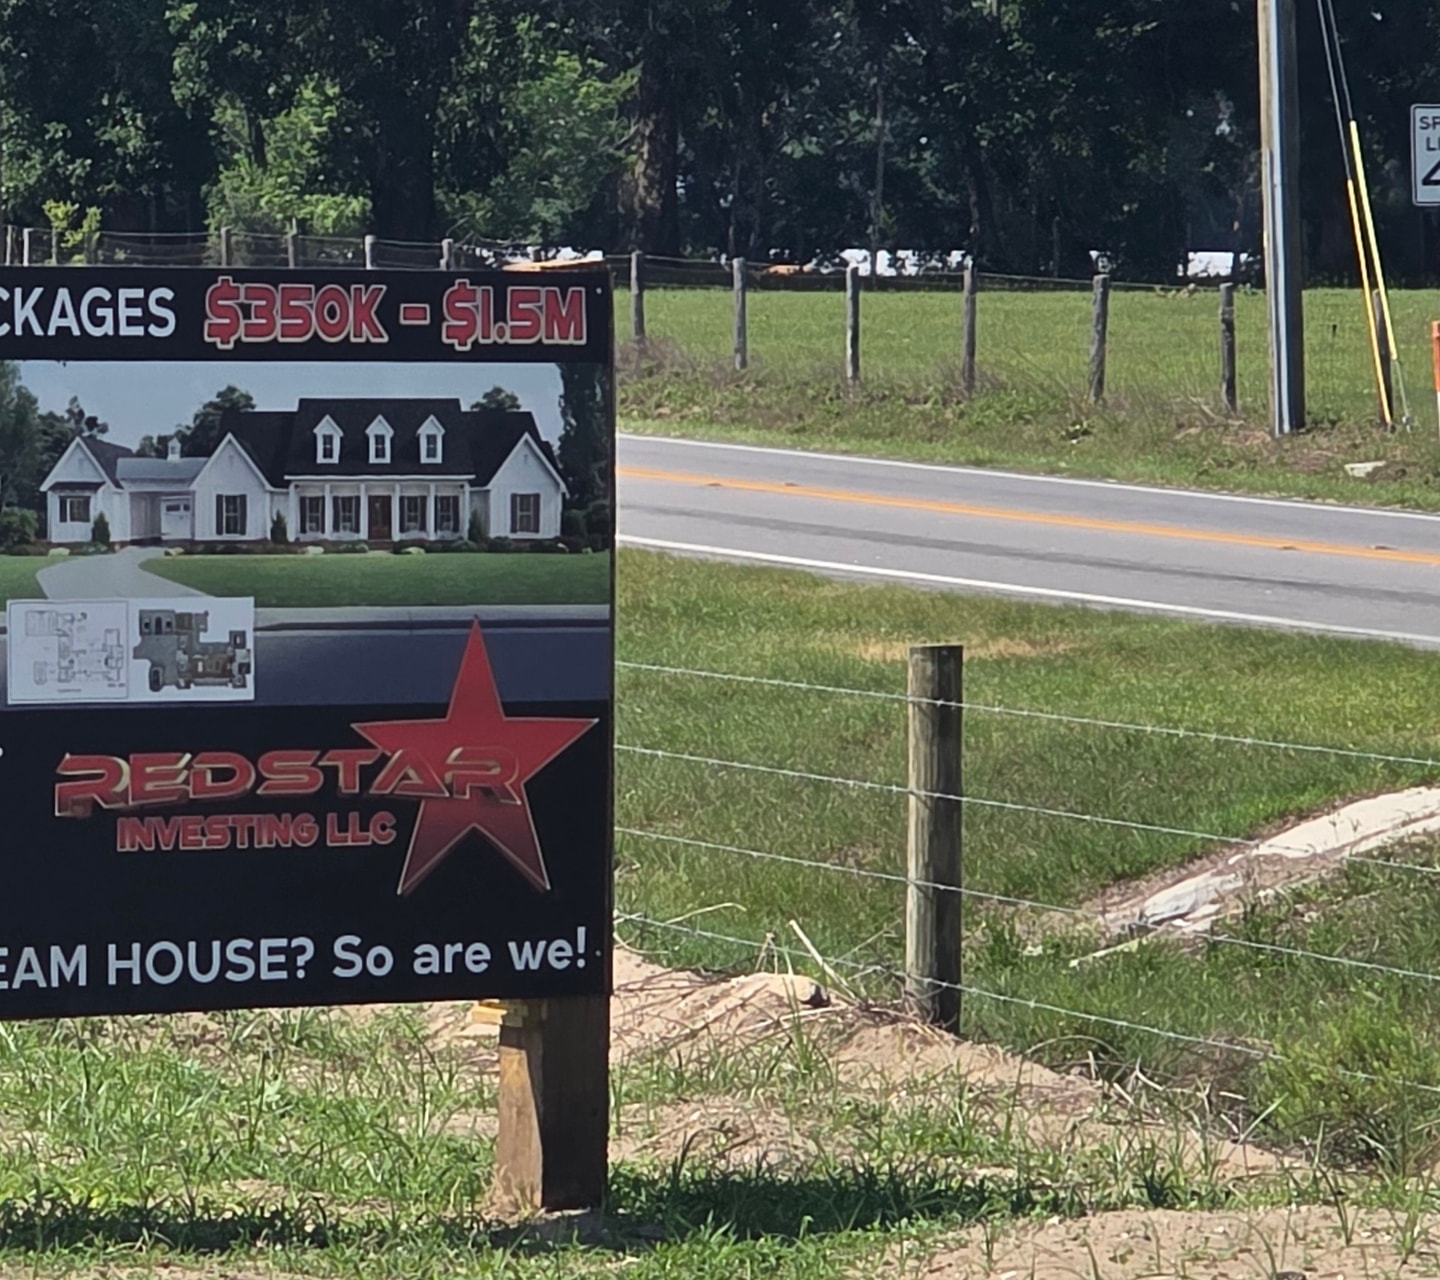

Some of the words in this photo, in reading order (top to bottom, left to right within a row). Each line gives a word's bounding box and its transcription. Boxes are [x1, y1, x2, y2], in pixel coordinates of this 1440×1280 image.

[203, 275, 389, 350] $350K
[441, 279, 589, 351] $1.5M
[116, 813, 318, 852] INVESTING
[325, 812, 398, 847] LLC
[106, 936, 315, 986] HOUSE?
[332, 934, 394, 979] So
[412, 941, 492, 975] are
[509, 925, 588, 972] we!
